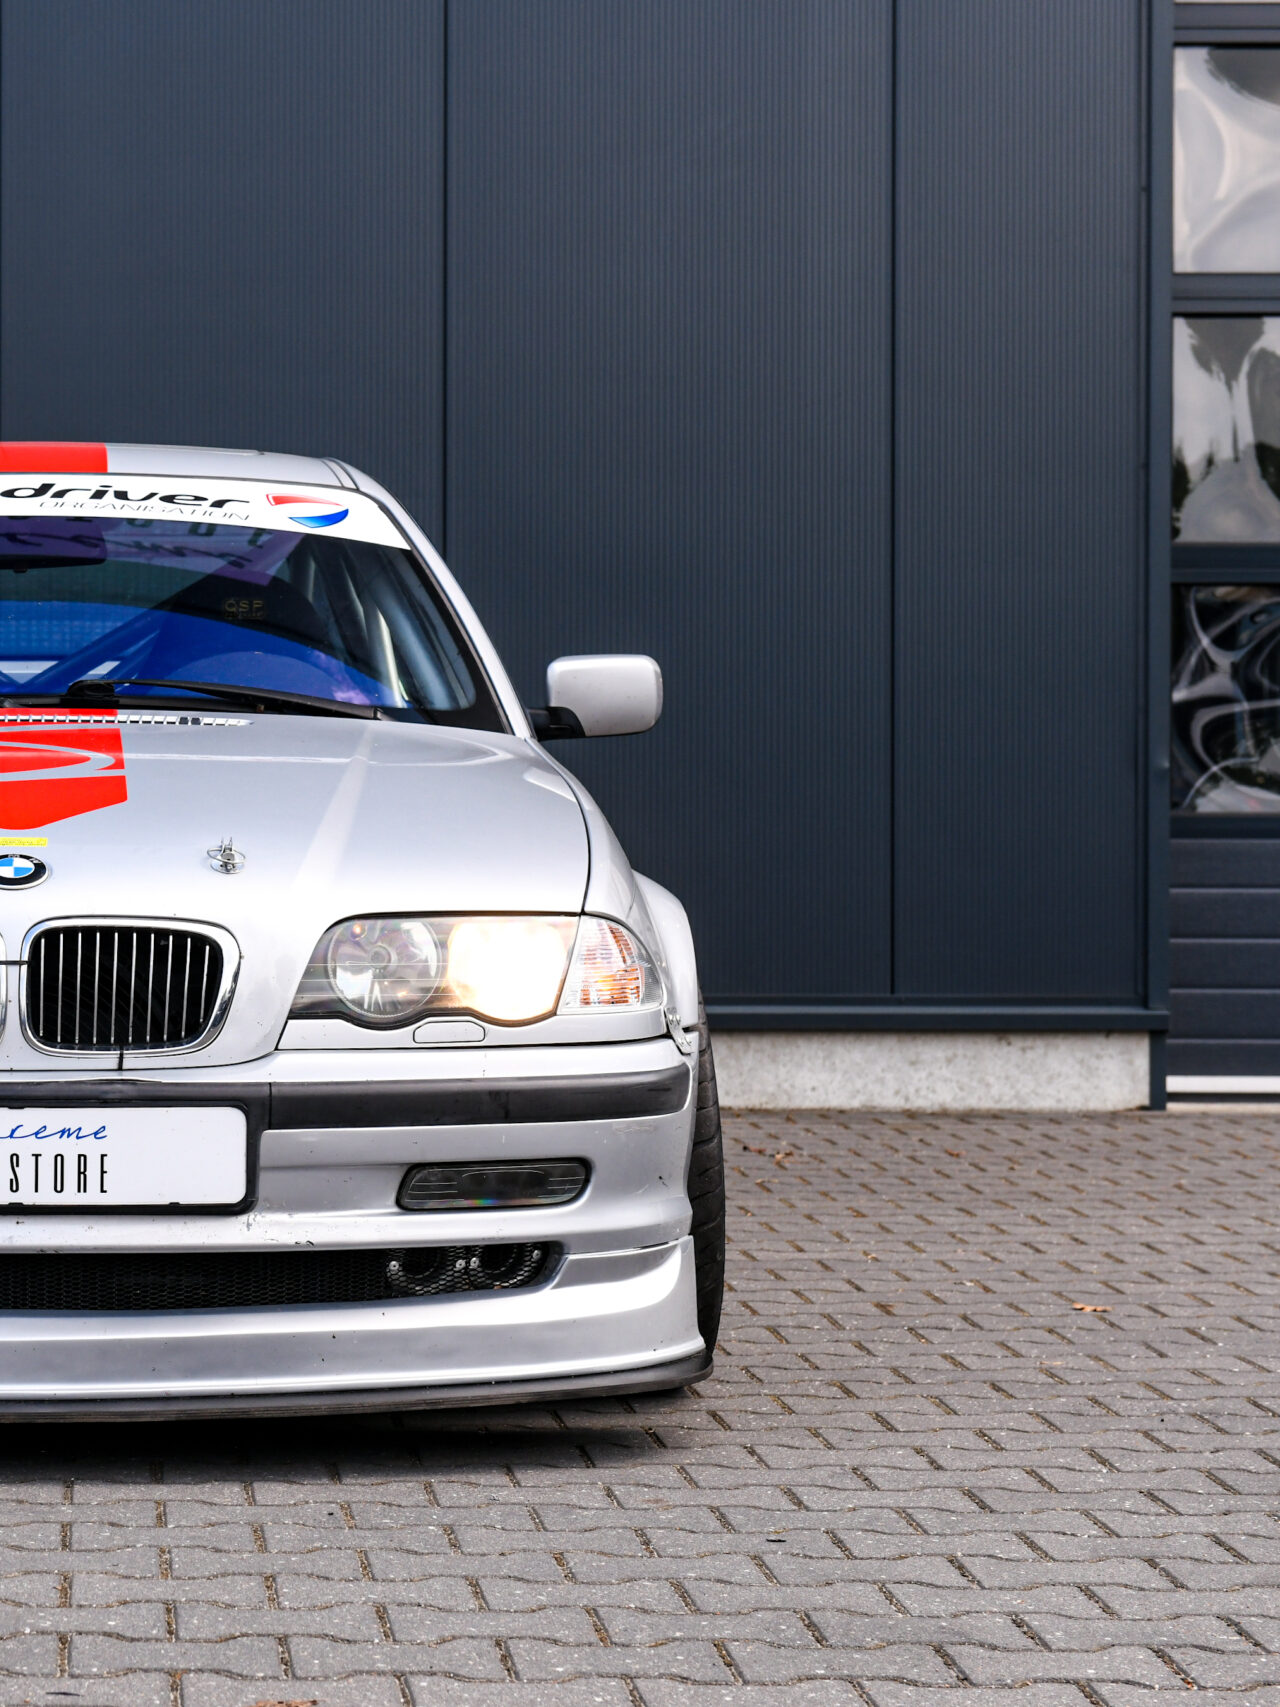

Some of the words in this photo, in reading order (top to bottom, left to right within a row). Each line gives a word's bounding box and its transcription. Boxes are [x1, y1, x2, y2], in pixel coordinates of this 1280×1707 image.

[0, 482, 250, 509] driver
[38, 501, 250, 521] ORGANISATION
[9, 1152, 108, 1194] STORE
